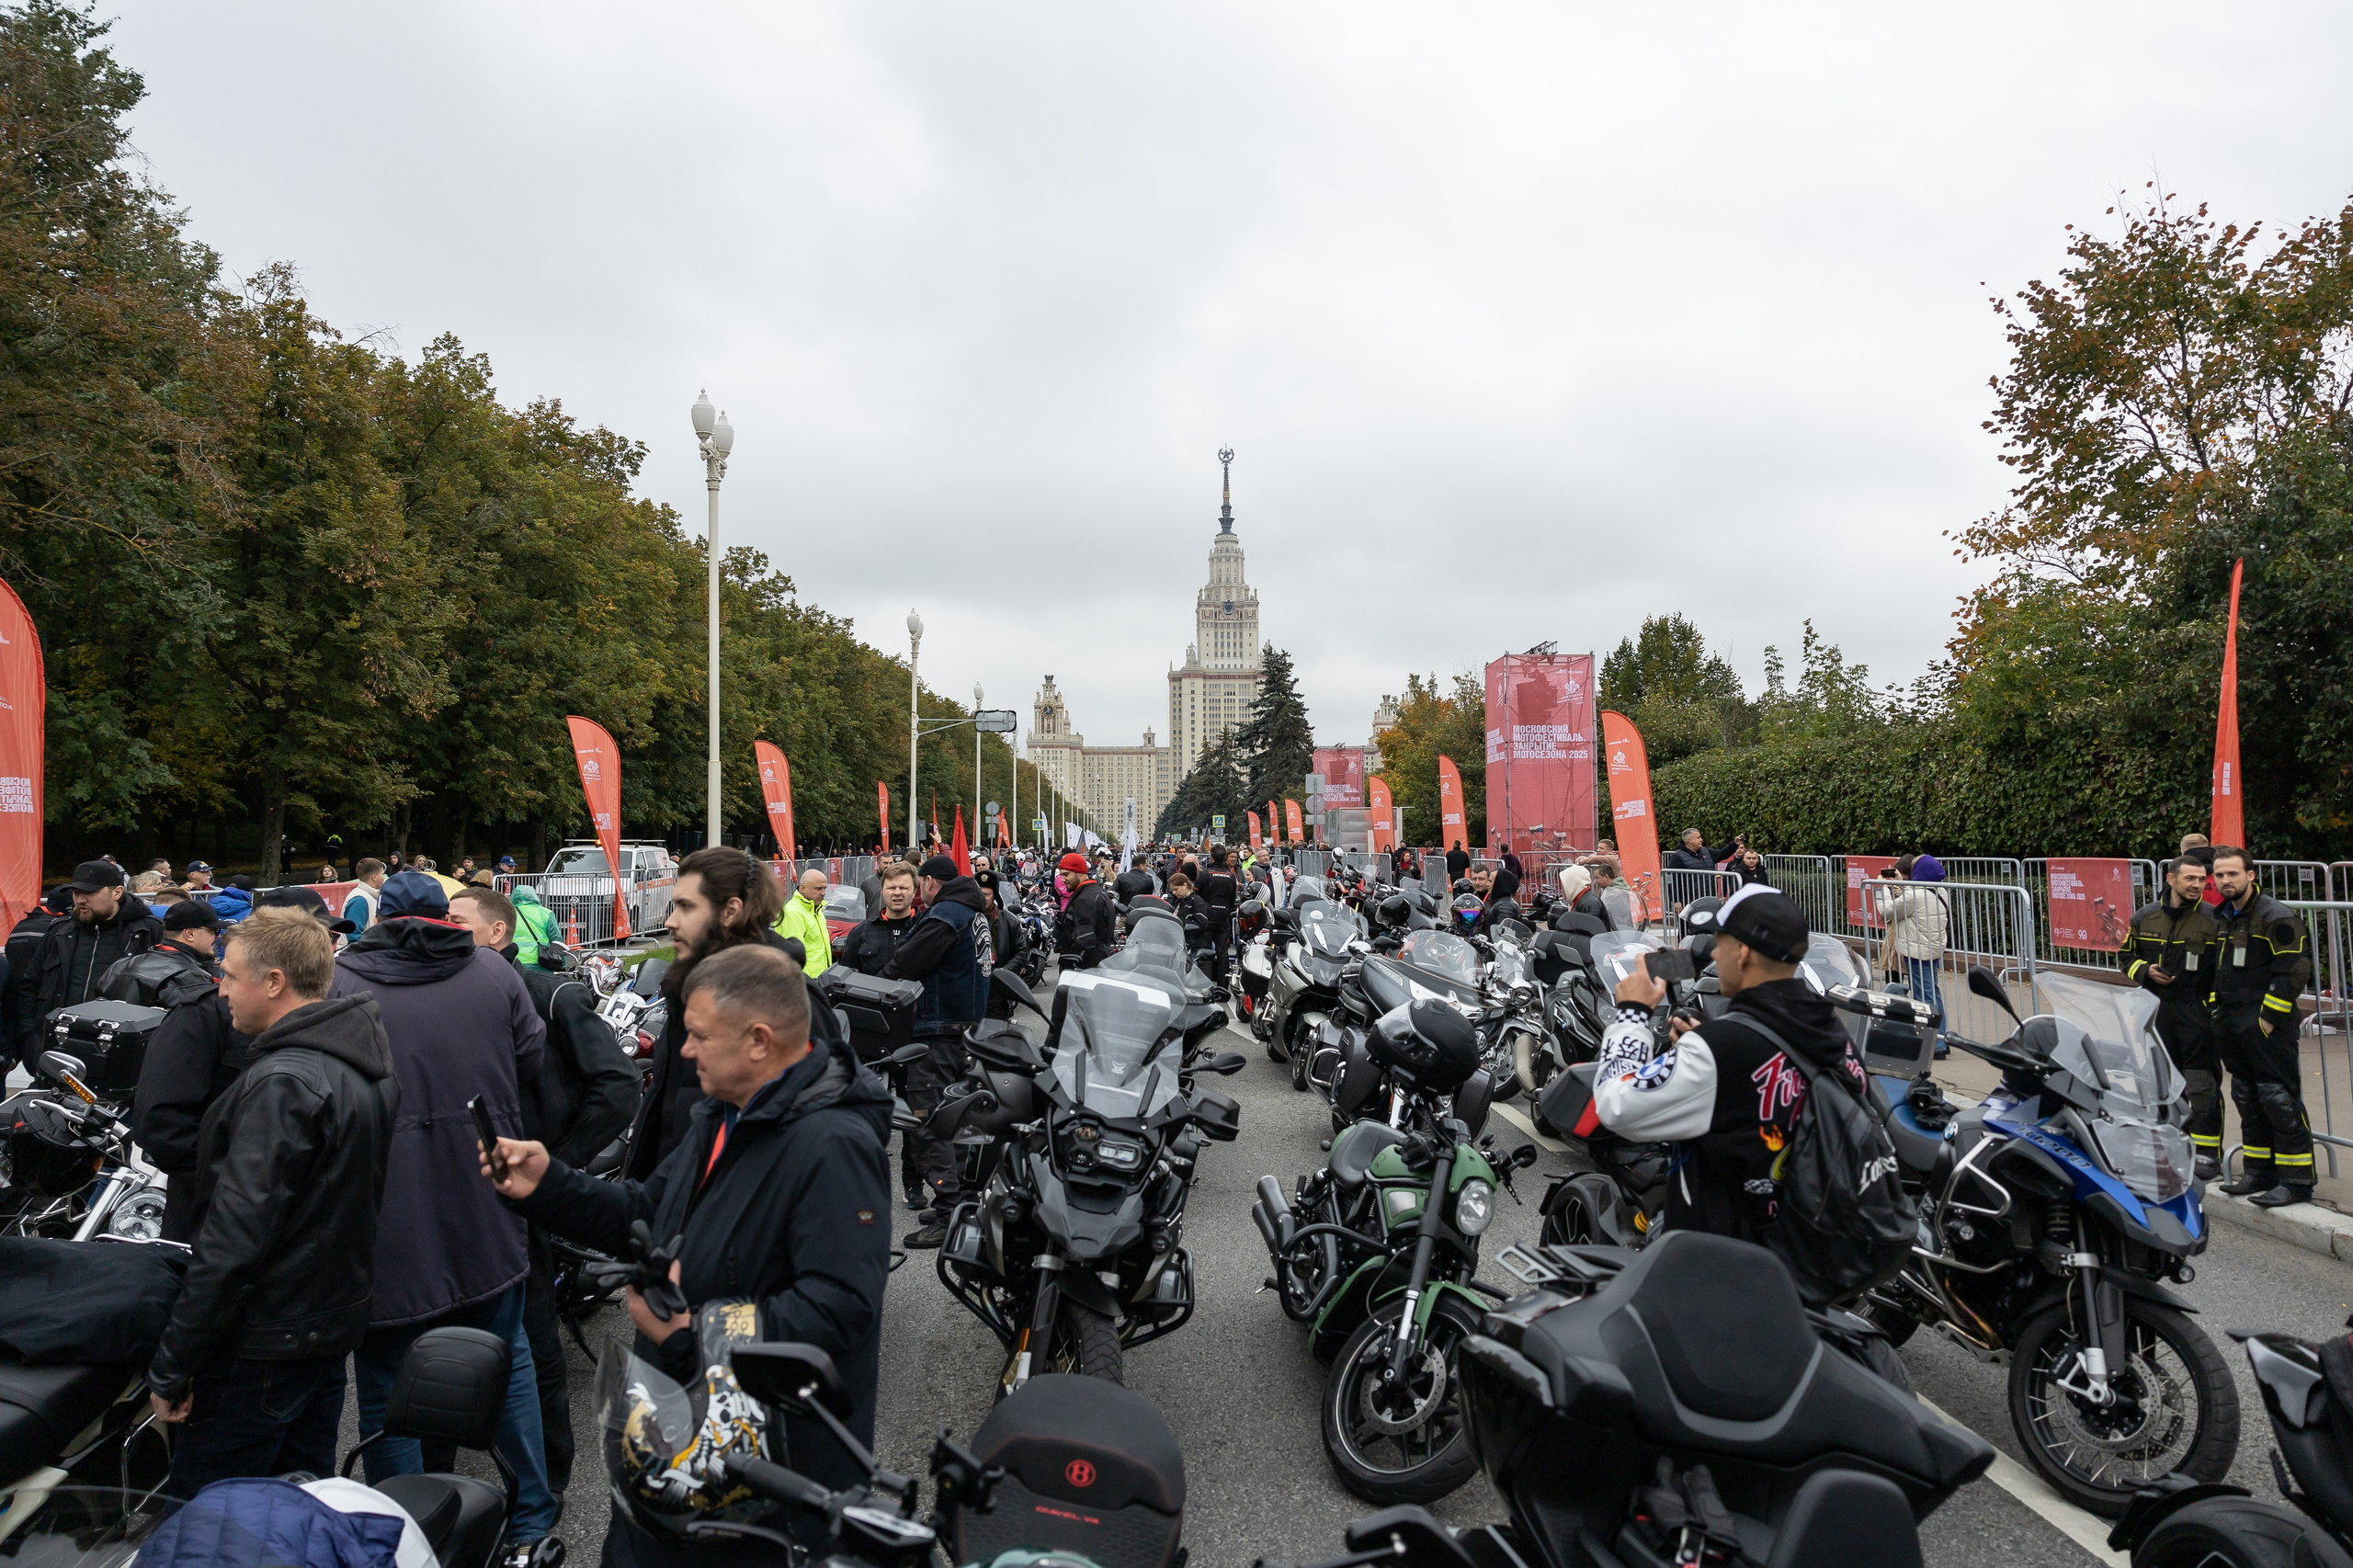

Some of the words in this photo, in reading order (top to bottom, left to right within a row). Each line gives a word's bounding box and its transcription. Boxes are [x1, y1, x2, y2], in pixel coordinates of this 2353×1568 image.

[1513, 723, 1569, 733] МОСКОВСКИЙ
[1513, 733, 1586, 742] МОТОФЕСТИВАЛЬ.
[1513, 742, 1557, 750] ЗАКРЫТИЕ
[1513, 750, 1567, 759] МОТОСЕЗОНА
[1569, 750, 1588, 759] 2025
